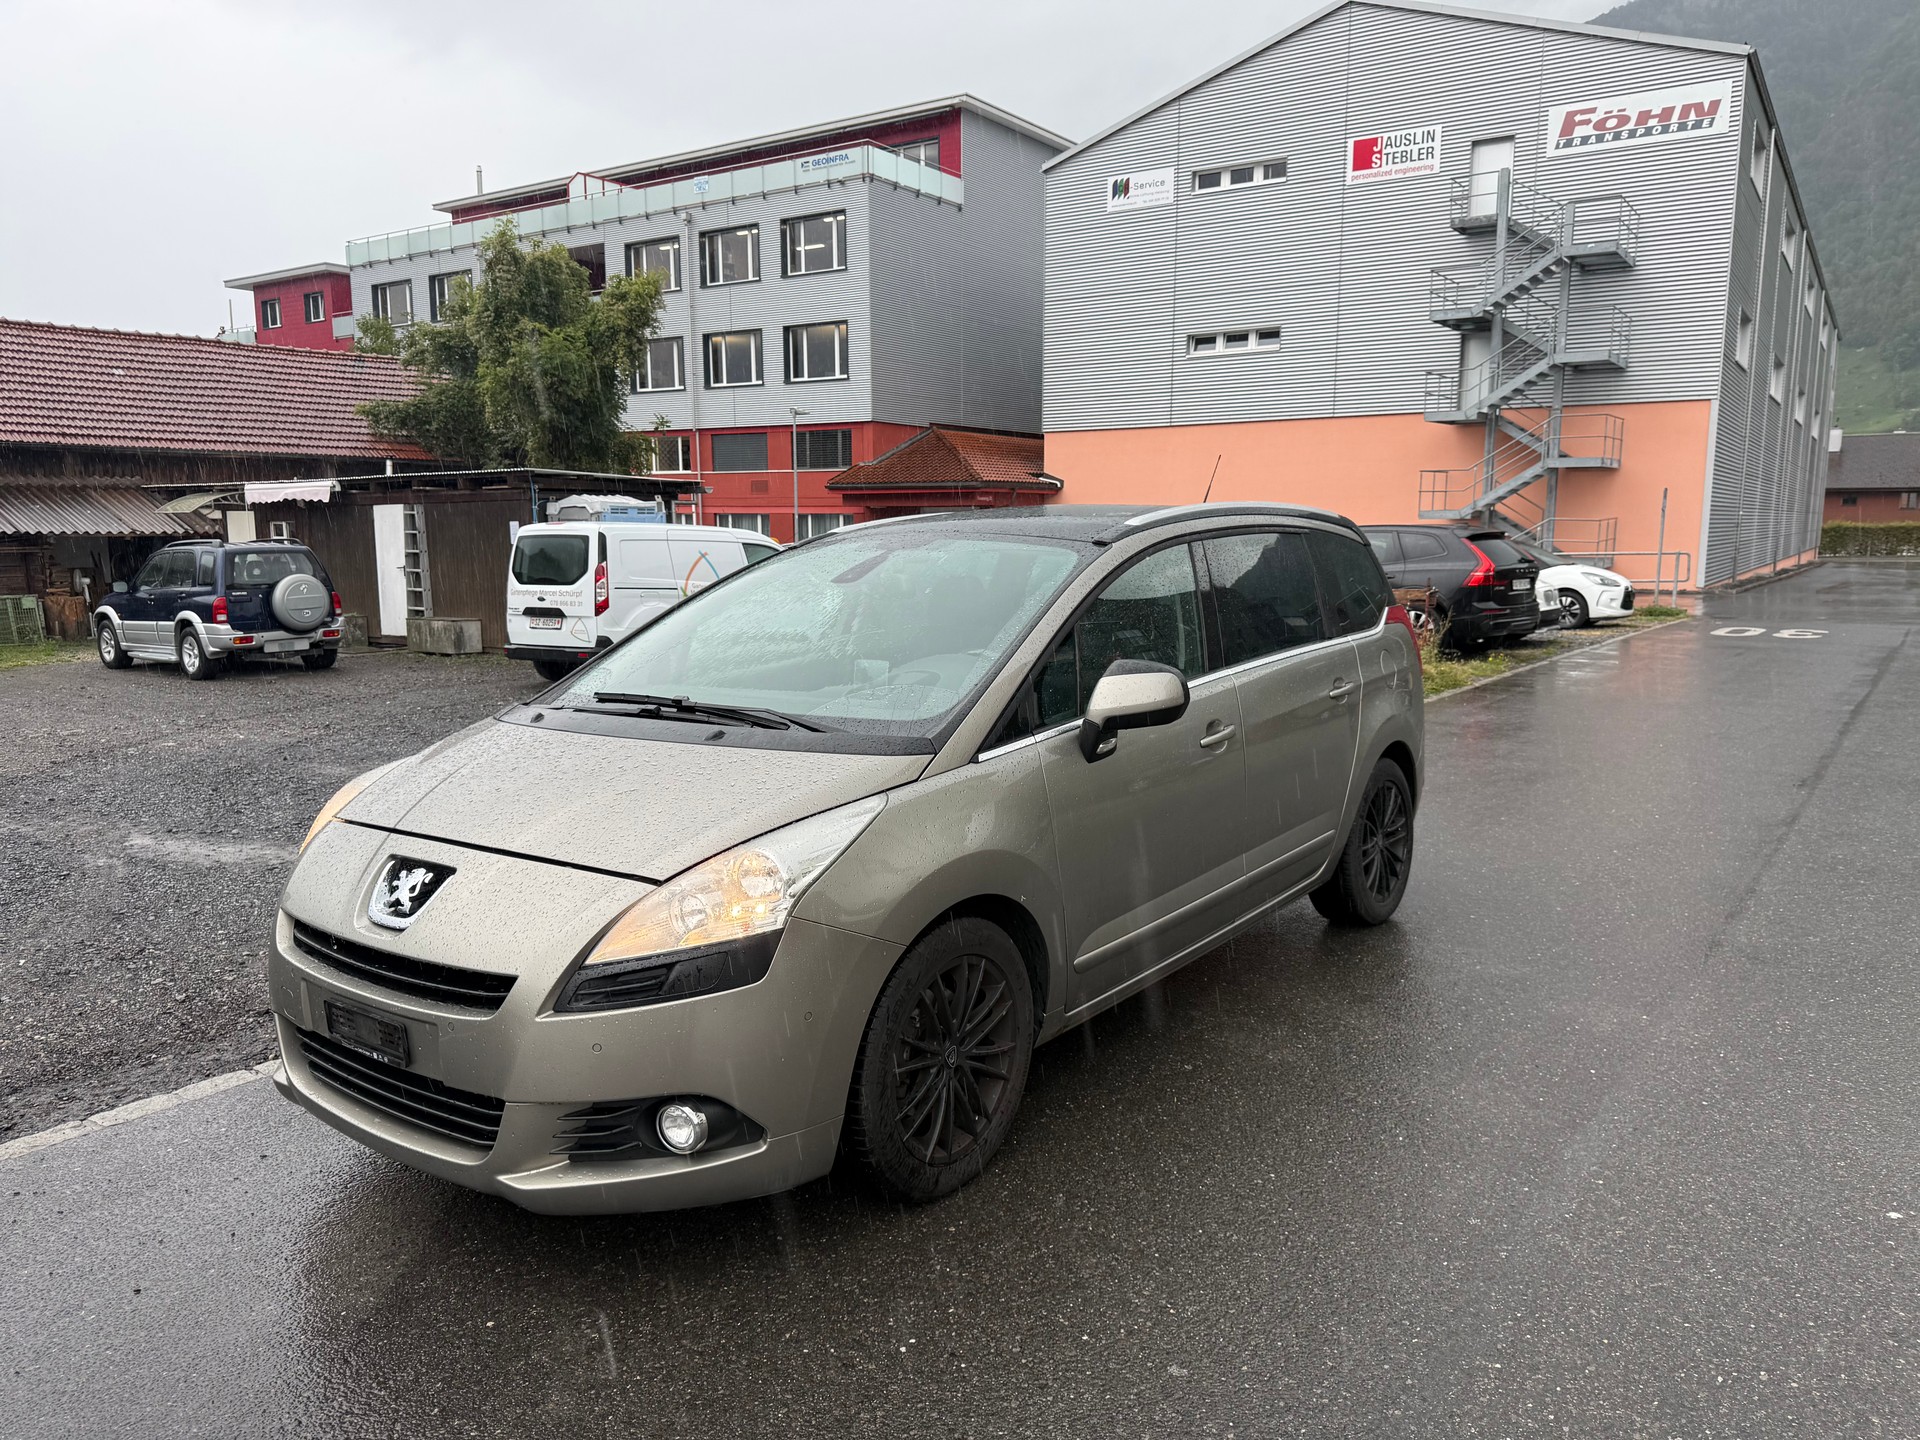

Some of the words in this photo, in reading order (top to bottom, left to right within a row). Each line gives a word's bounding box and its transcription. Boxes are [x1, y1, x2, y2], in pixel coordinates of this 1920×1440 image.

[1558, 98, 1722, 138] FÖHN
[1373, 129, 1436, 152] JAUSLIN
[1557, 119, 1712, 149] TRANSPORTE
[811, 153, 850, 167] GEOINFRA
[1371, 146, 1435, 168] STEBLER
[1350, 169, 1393, 182] personalized
[1394, 163, 1435, 176] engineering
[539, 589, 557, 597] Marcel
[558, 589, 583, 599] Schürpf
